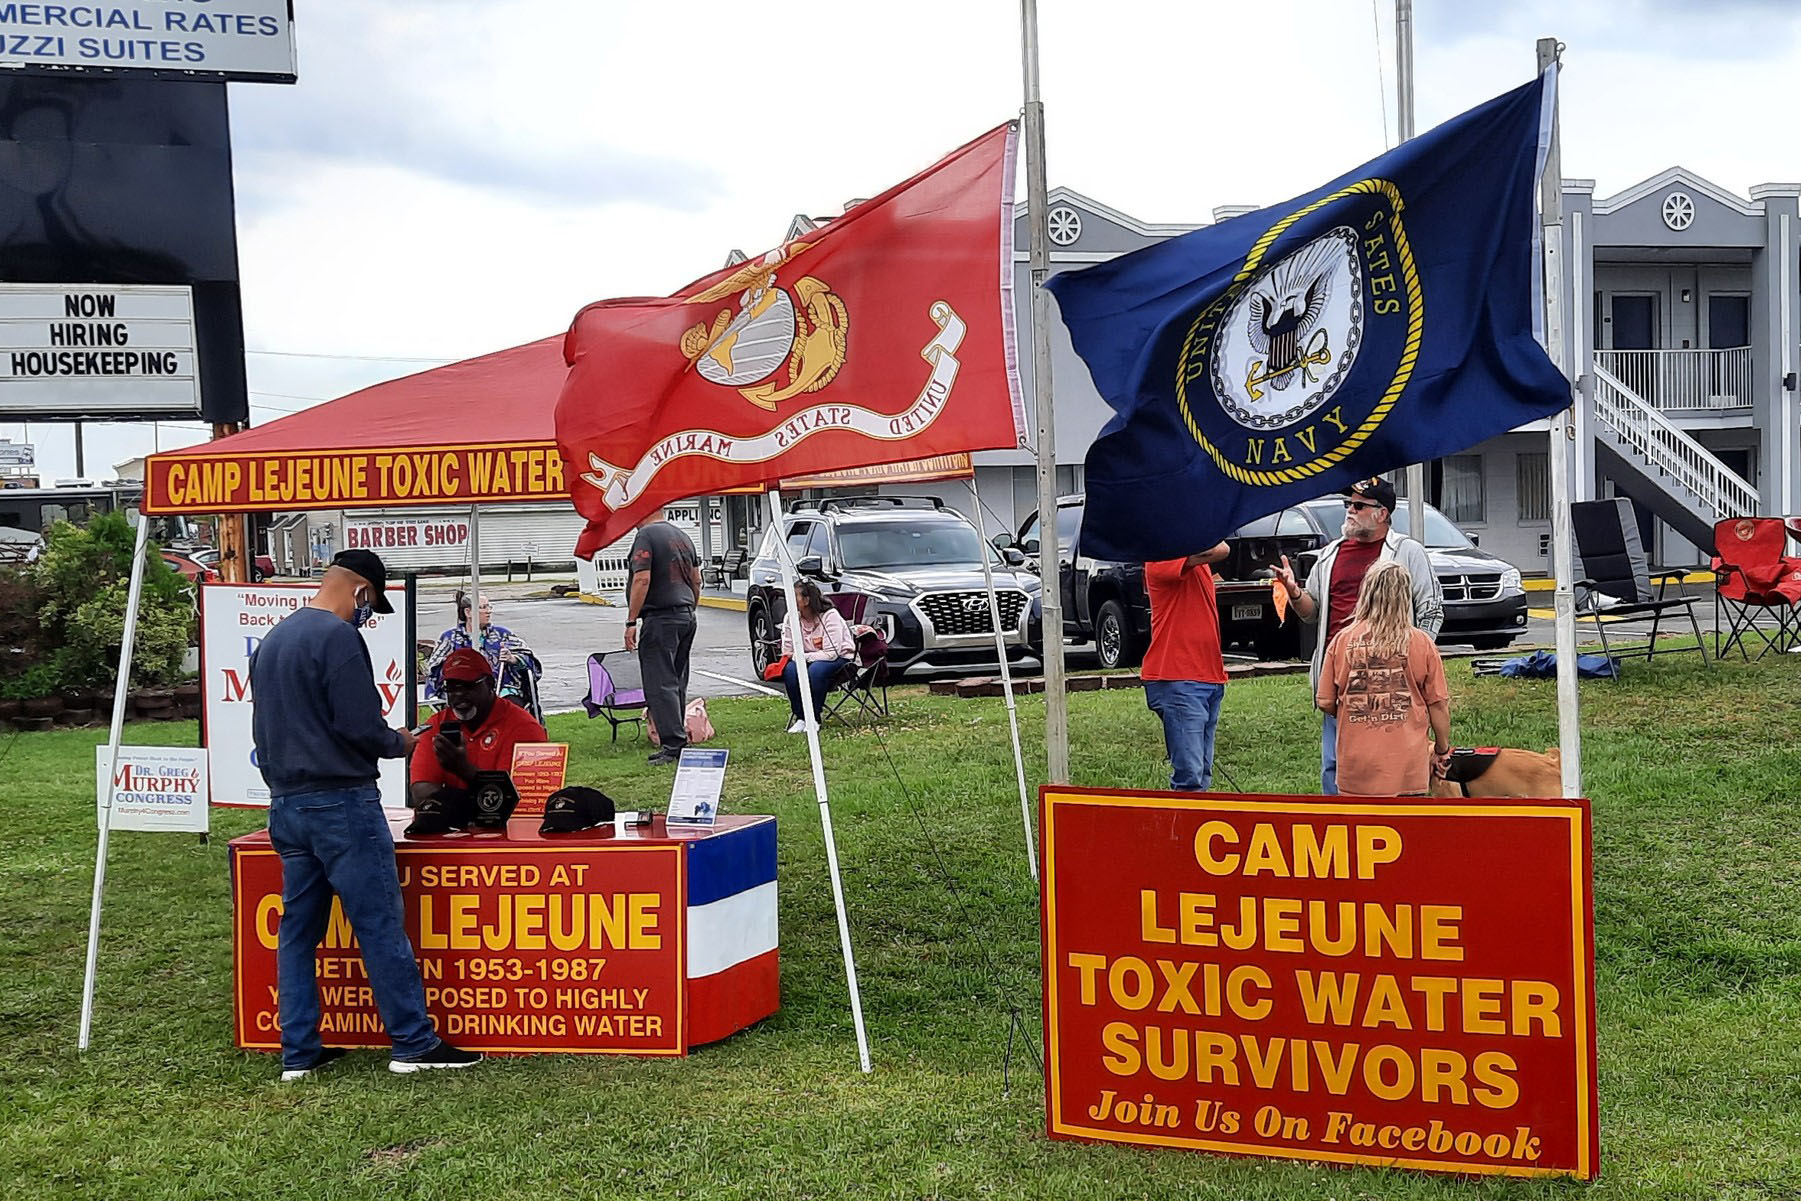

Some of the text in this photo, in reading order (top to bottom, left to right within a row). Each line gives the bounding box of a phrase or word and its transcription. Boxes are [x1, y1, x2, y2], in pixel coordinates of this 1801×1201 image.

[165, 11, 279, 36] RATES
[0, 34, 206, 62] ZZI SUITES
[64, 294, 116, 318] NOW
[49, 323, 129, 346] HIRING
[11, 352, 178, 376] HOUSEKEEPING
[1245, 405, 1348, 465] NAVY
[167, 461, 241, 505] CAMP
[249, 456, 368, 502] LEJEUNE
[375, 452, 460, 498] TOXIC
[467, 449, 565, 494] WATER
[347, 524, 468, 548] BARBER SHOP
[239, 613, 275, 626] Back
[114, 764, 200, 793] MURPHY
[116, 792, 193, 805] CONGRESS
[1193, 819, 1403, 880] CAMP
[421, 864, 541, 887] SERVED
[549, 864, 589, 887] AT
[419, 893, 662, 952] LEJEUNE
[1140, 889, 1464, 962] LEJEUNE
[454, 958, 606, 981] 1953-1987
[426, 987, 508, 1009] POSED
[514, 988, 548, 1009] TO
[556, 988, 649, 1010] HIGHLY
[1068, 952, 1563, 1039] TOXIC WATER
[447, 1014, 566, 1036] DRINKING
[574, 1015, 663, 1038] WATER
[1101, 1021, 1521, 1110] SURVIVORS
[1088, 1090, 1542, 1162] Join Us On Facebook
